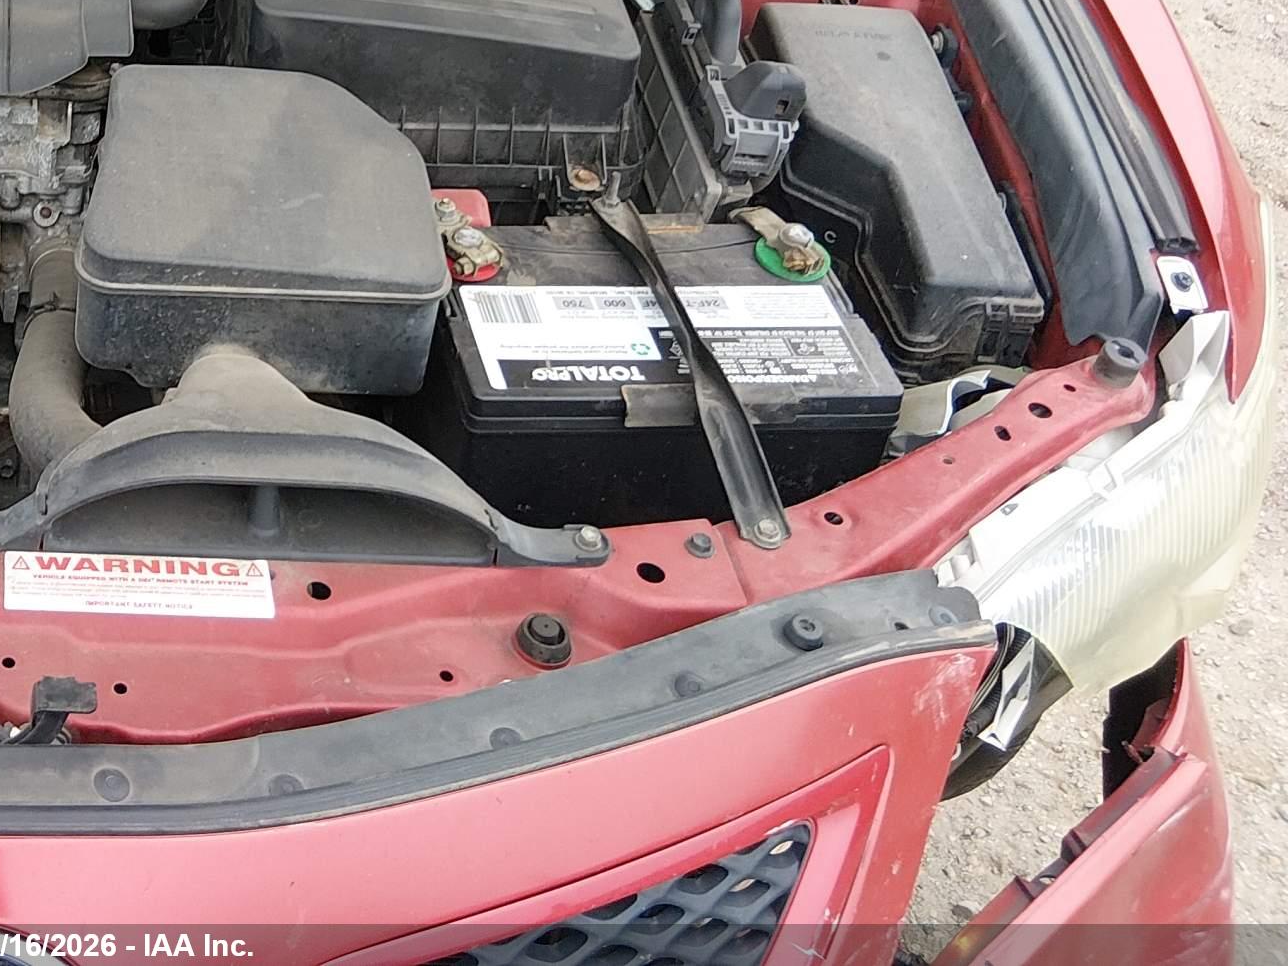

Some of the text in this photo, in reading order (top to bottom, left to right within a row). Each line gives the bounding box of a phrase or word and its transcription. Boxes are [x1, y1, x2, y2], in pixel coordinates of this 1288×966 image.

[562, 299, 584, 308] 750
[603, 299, 626, 308] 600
[642, 299, 658, 309] 4F
[531, 365, 646, 382] TOTALPRO
[35, 556, 240, 577] WARNING
[85, 600, 131, 608] IMPORTANT
